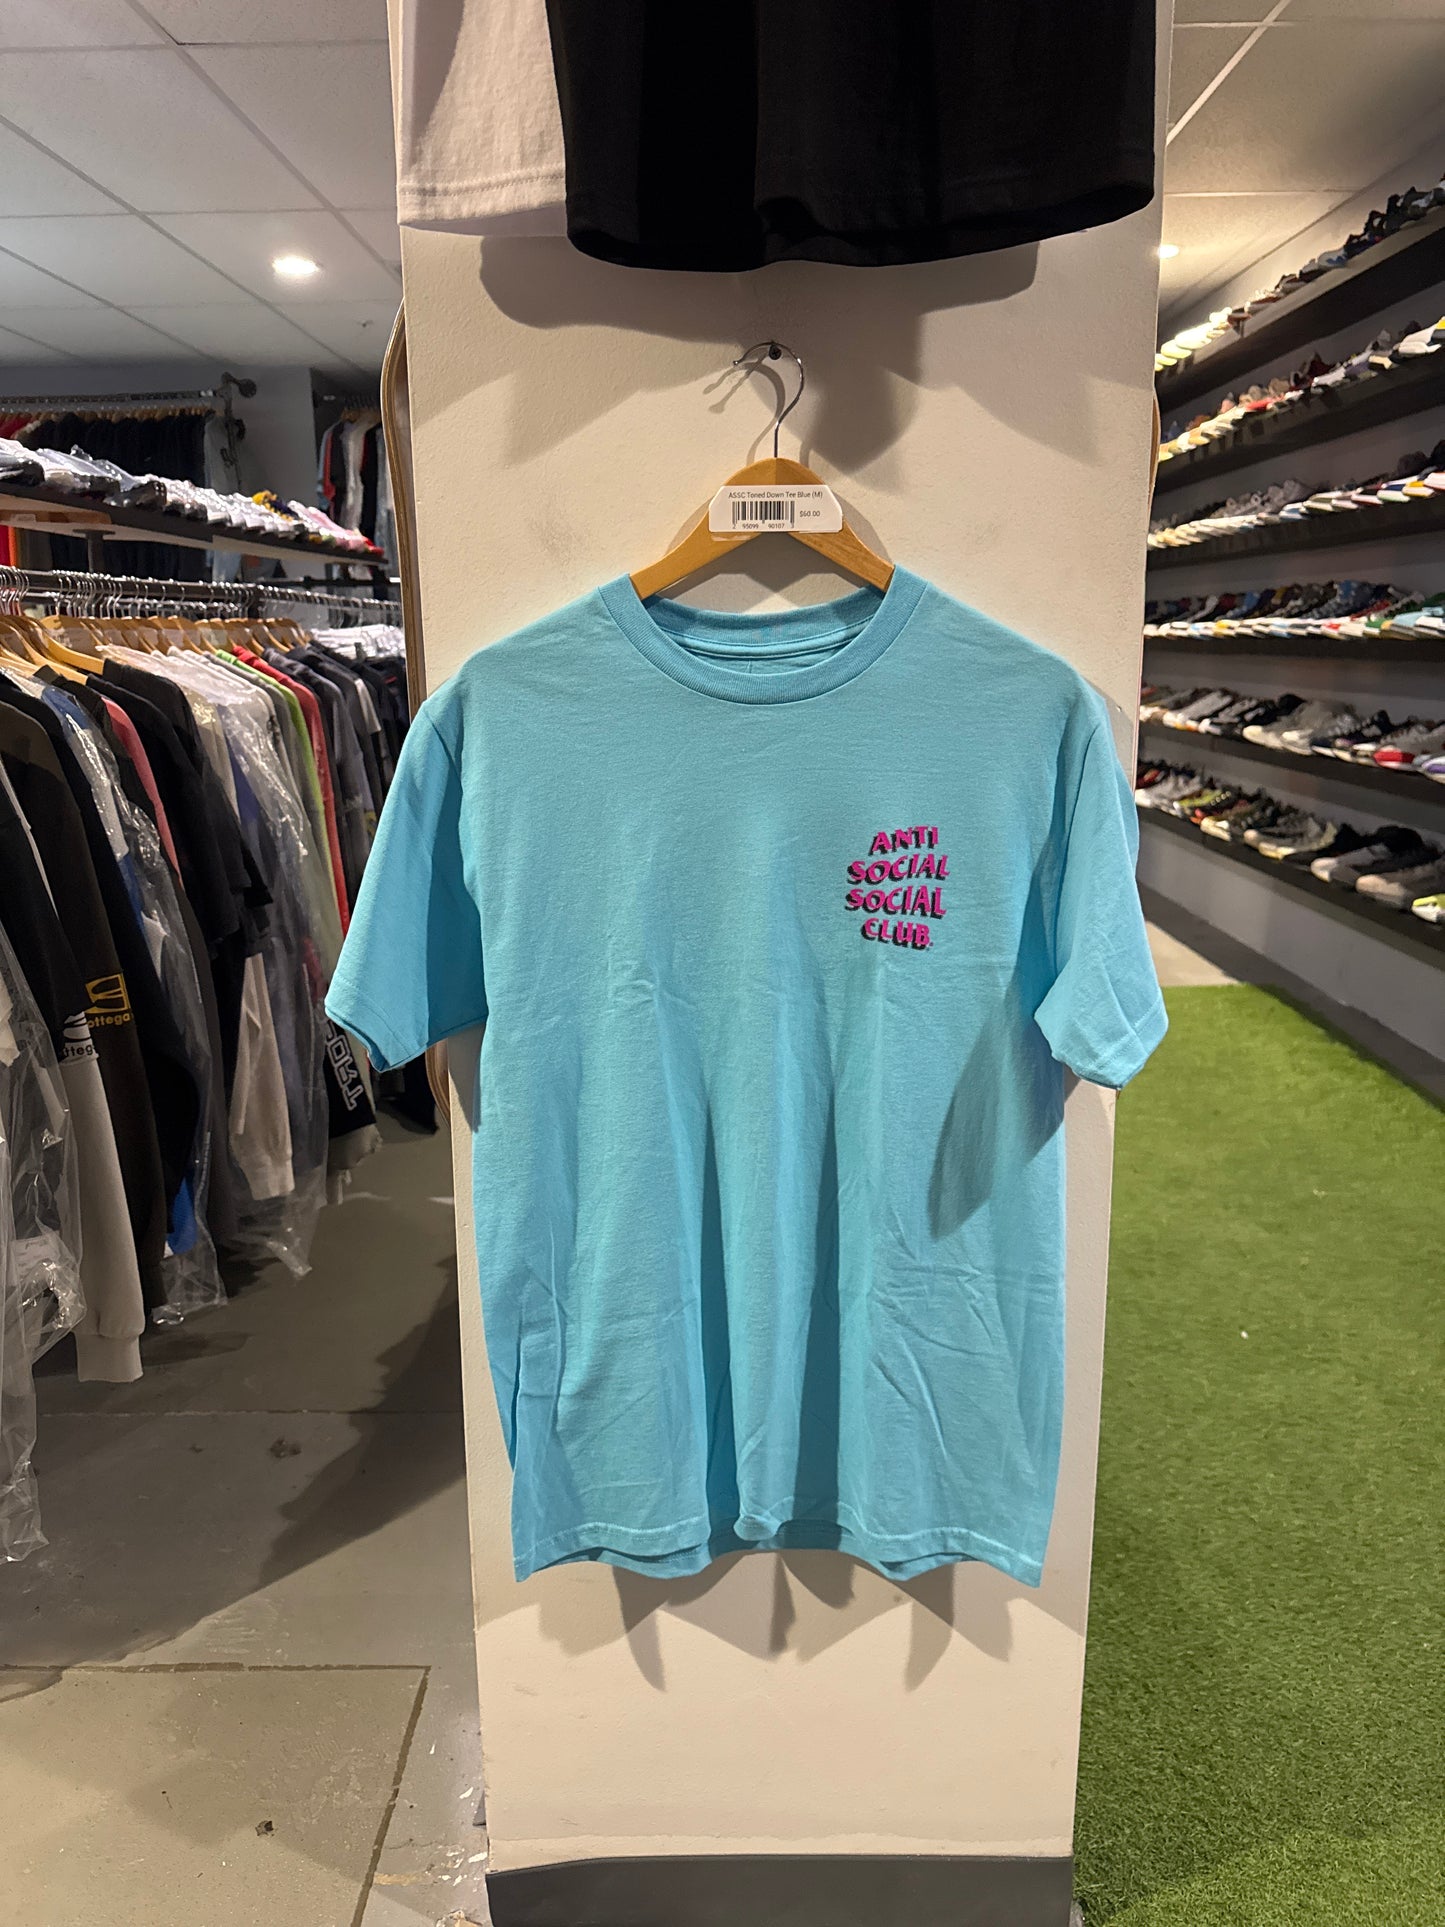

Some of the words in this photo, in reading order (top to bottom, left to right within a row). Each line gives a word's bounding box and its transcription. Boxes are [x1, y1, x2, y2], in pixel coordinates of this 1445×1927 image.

[728, 491, 746, 499] ASSC
[747, 491, 766, 499] Toned
[766, 491, 784, 499] Down
[786, 491, 796, 499] Tee
[797, 491, 811, 499] Blue
[811, 491, 823, 499] (M)
[799, 510, 821, 518] $60.00
[868, 826, 938, 856] ANTI
[846, 853, 950, 885] SOCIAL
[844, 884, 947, 920] SOCIAL
[87, 1013, 130, 1026] ottega
